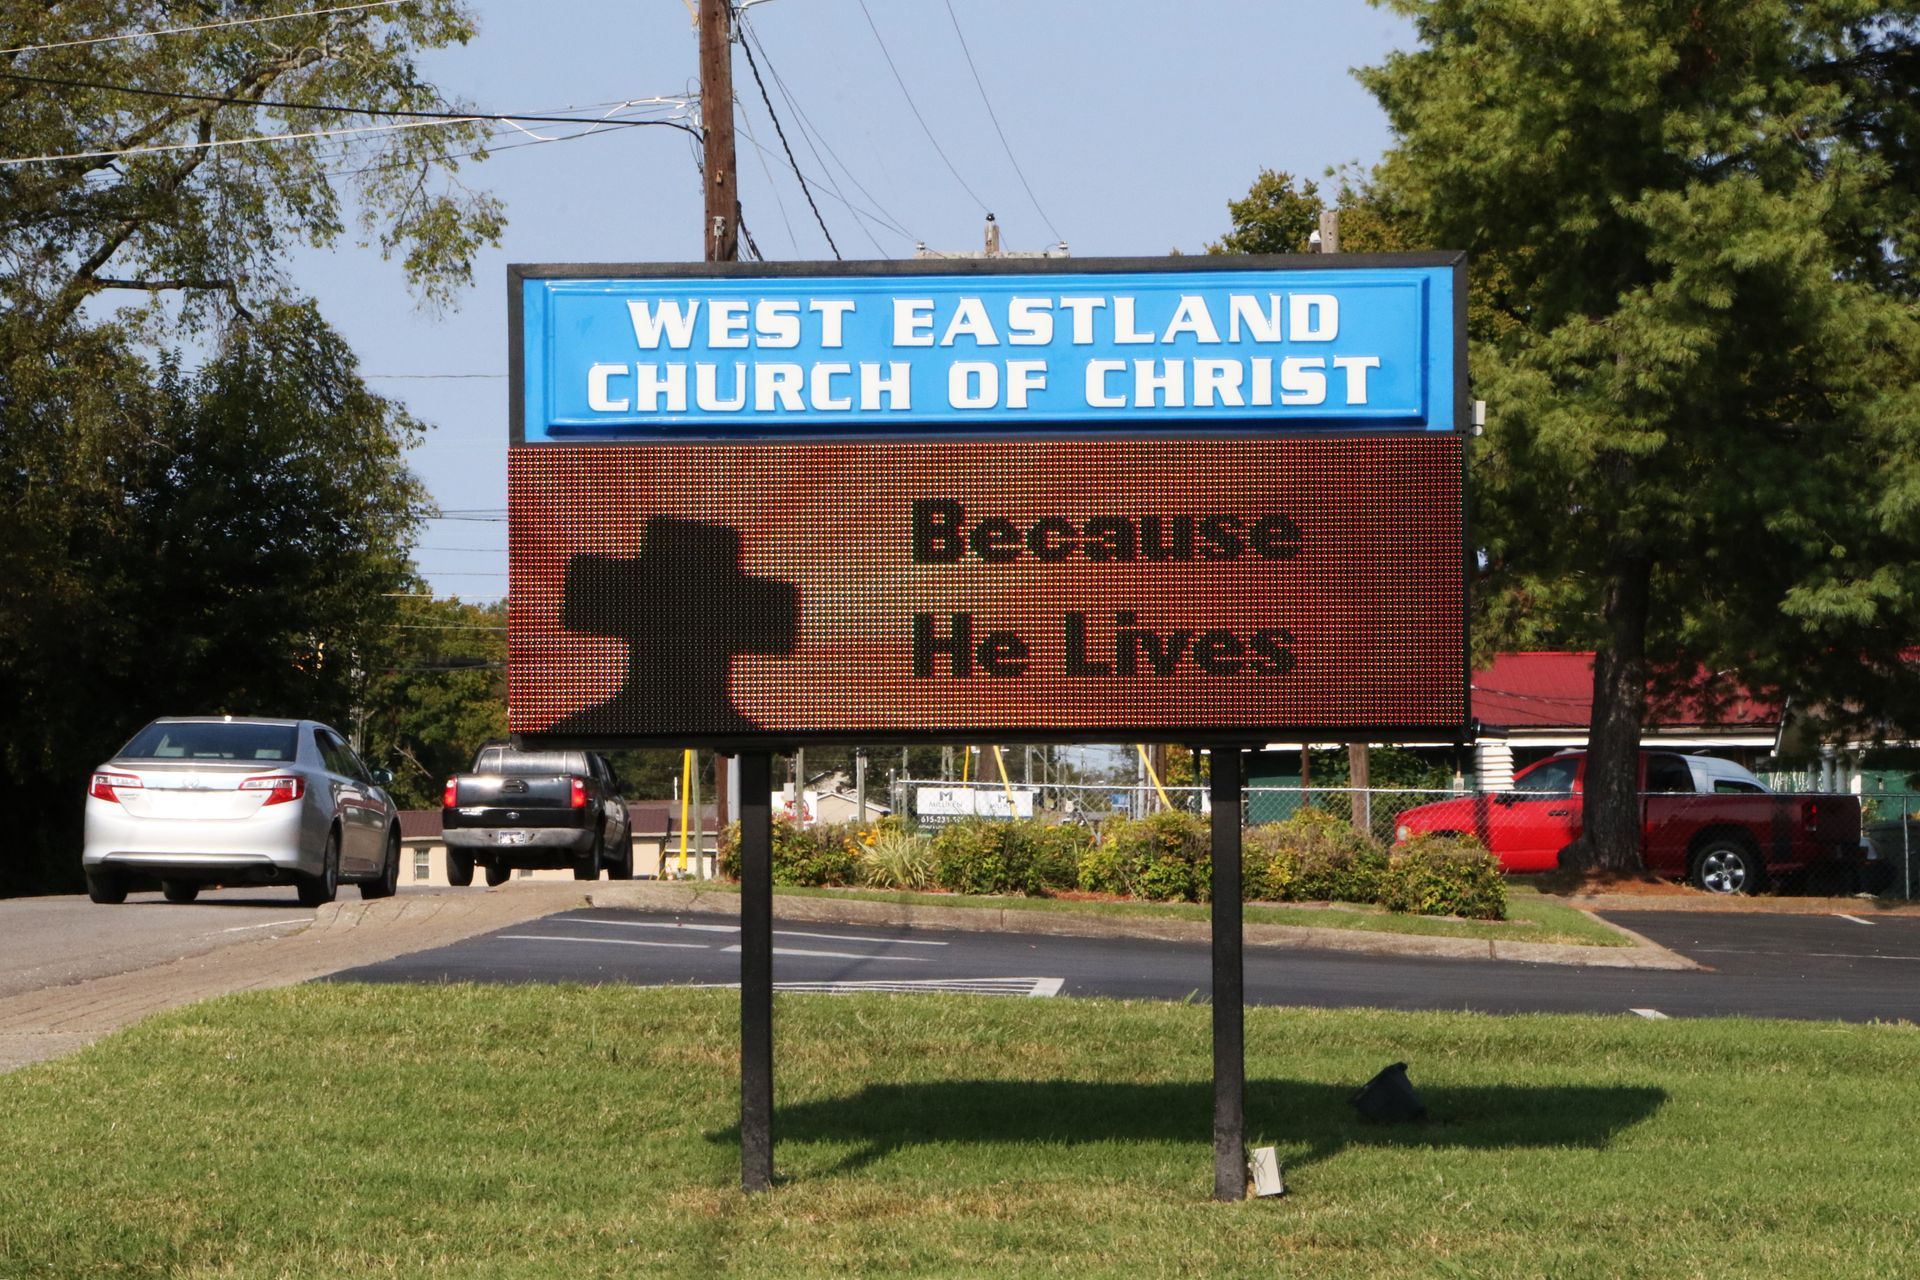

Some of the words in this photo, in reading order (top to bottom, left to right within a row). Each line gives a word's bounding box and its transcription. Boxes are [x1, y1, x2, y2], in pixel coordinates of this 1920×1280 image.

[626, 298, 857, 350] WEST
[892, 293, 1340, 348] EASTLAND
[587, 361, 913, 414] CHURCH
[947, 360, 1048, 412] OF
[1084, 355, 1381, 409] CHRIST
[912, 498, 1303, 565] Because
[912, 612, 1031, 679] He
[1065, 611, 1297, 678] Lives
